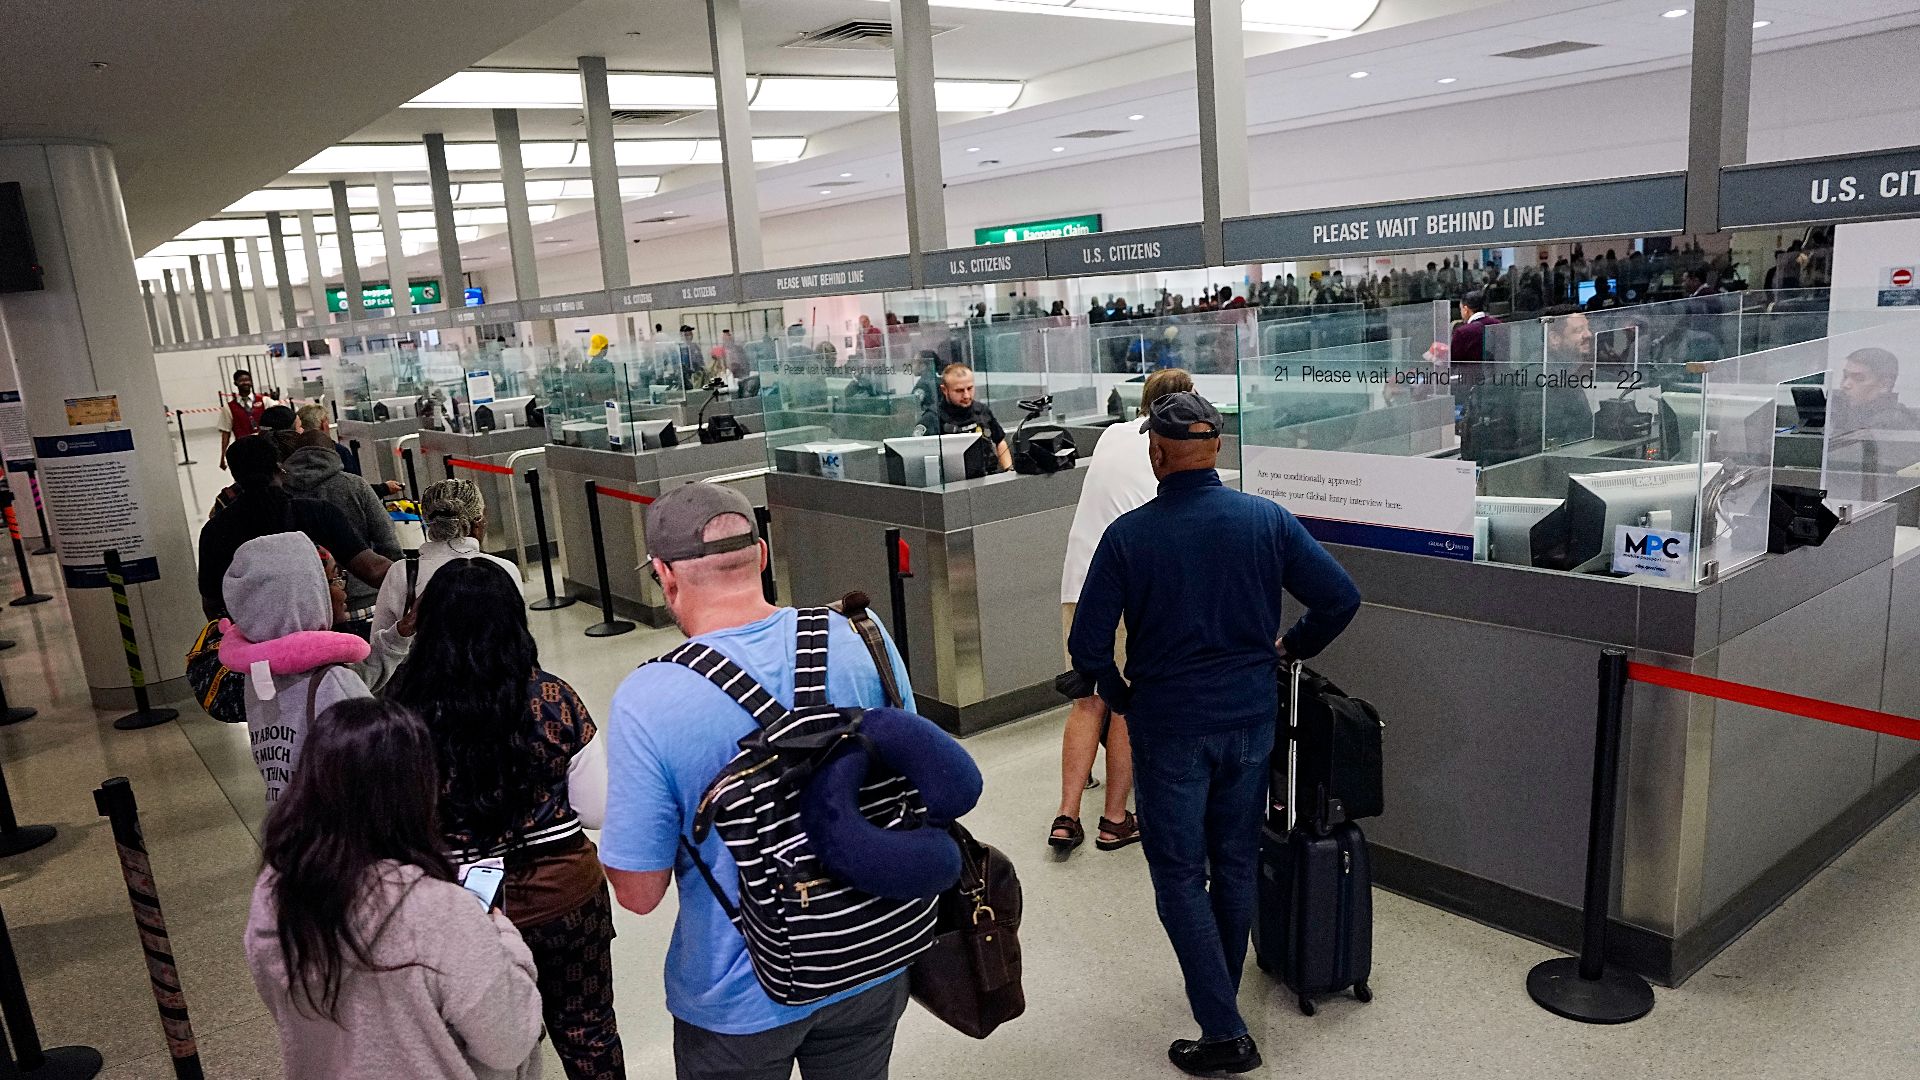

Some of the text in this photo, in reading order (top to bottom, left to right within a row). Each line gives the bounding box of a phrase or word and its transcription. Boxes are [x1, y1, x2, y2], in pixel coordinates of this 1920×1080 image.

[1811, 176, 1865, 204] U.S.
[1063, 224, 1089, 237] Claim
[1313, 204, 1545, 244] PLEASE WAIT BEHIND LINE
[1083, 242, 1161, 264] U.S. CITIZENS
[950, 256, 1012, 275] U.S. CITIZENS
[776, 270, 865, 290] PLEASE WAIT BEHIND LINE
[693, 285, 717, 298] CITIZENS
[903, 363, 913, 376] 20
[1274, 365, 1289, 382] 21
[1302, 365, 1351, 383] Please
[1357, 367, 1393, 385] wait
[1395, 367, 1450, 386] behind
[1492, 369, 1528, 387] until
[1536, 369, 1597, 390] called.
[1617, 370, 1642, 390] 22
[1257, 469, 1361, 487] Are you conditionally approved?
[1257, 487, 1403, 510] Complete your Global Entry interview here.
[1625, 532, 1681, 559] MPC
[260, 725, 297, 744] ABOUT
[260, 745, 291, 764] MUCH
